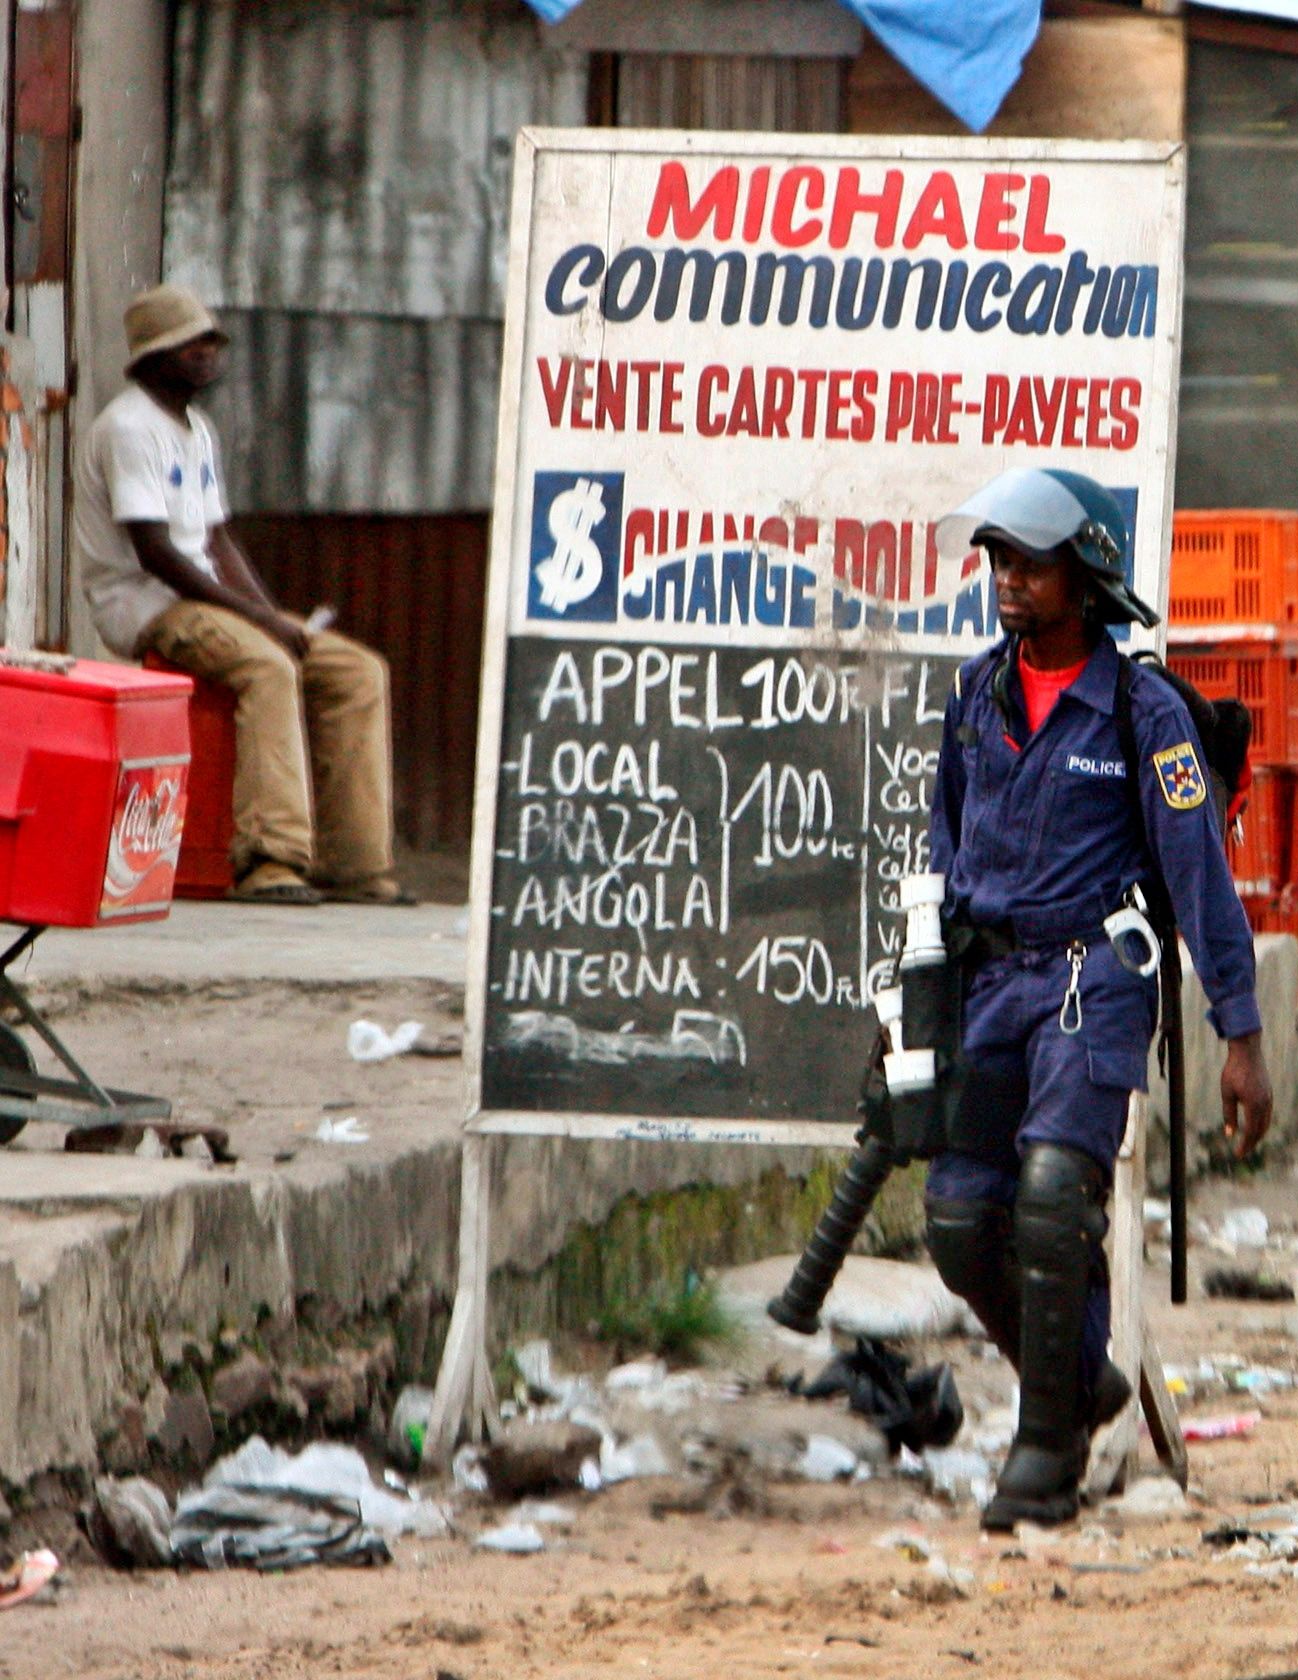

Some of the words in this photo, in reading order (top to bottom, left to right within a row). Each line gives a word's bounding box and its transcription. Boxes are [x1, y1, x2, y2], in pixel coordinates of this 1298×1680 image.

[647, 160, 1067, 253] MICHAEL
[537, 356, 684, 434] VENTE
[696, 364, 876, 442] CARTES
[622, 508, 820, 628] CHANGE
[538, 646, 744, 732] APPEL
[1068, 755, 1124, 776] POLICE
